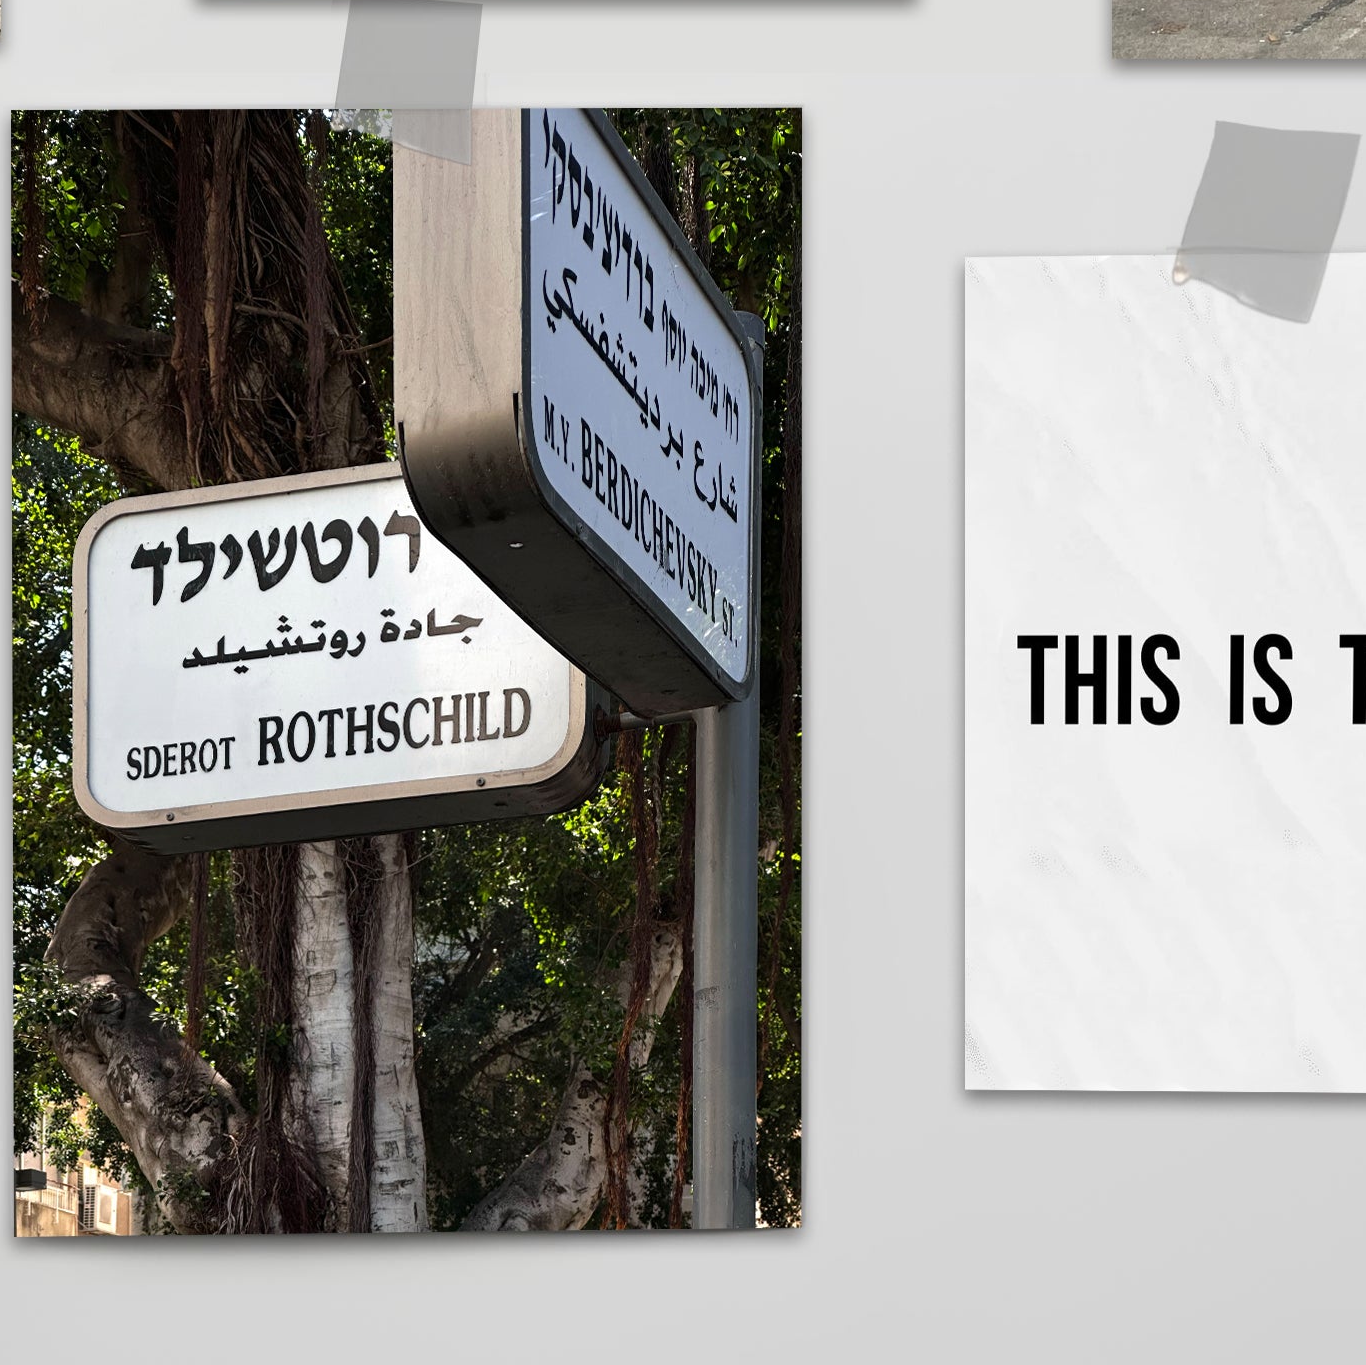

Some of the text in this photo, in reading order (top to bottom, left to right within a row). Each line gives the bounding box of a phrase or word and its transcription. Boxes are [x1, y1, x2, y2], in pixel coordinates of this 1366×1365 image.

[661, 299, 686, 372] יוסף
[690, 340, 718, 418] מיכה
[543, 394, 738, 648] M.Y. BERDICHEVSKY ST.
[693, 439, 737, 523] شارع
[130, 509, 421, 606] רוטשילד
[182, 608, 484, 674] جادة روتشيلد
[1017, 634, 1181, 726] THIS
[1229, 634, 1294, 726] IS
[126, 687, 532, 781] SDEROT ROTHSCHILD
